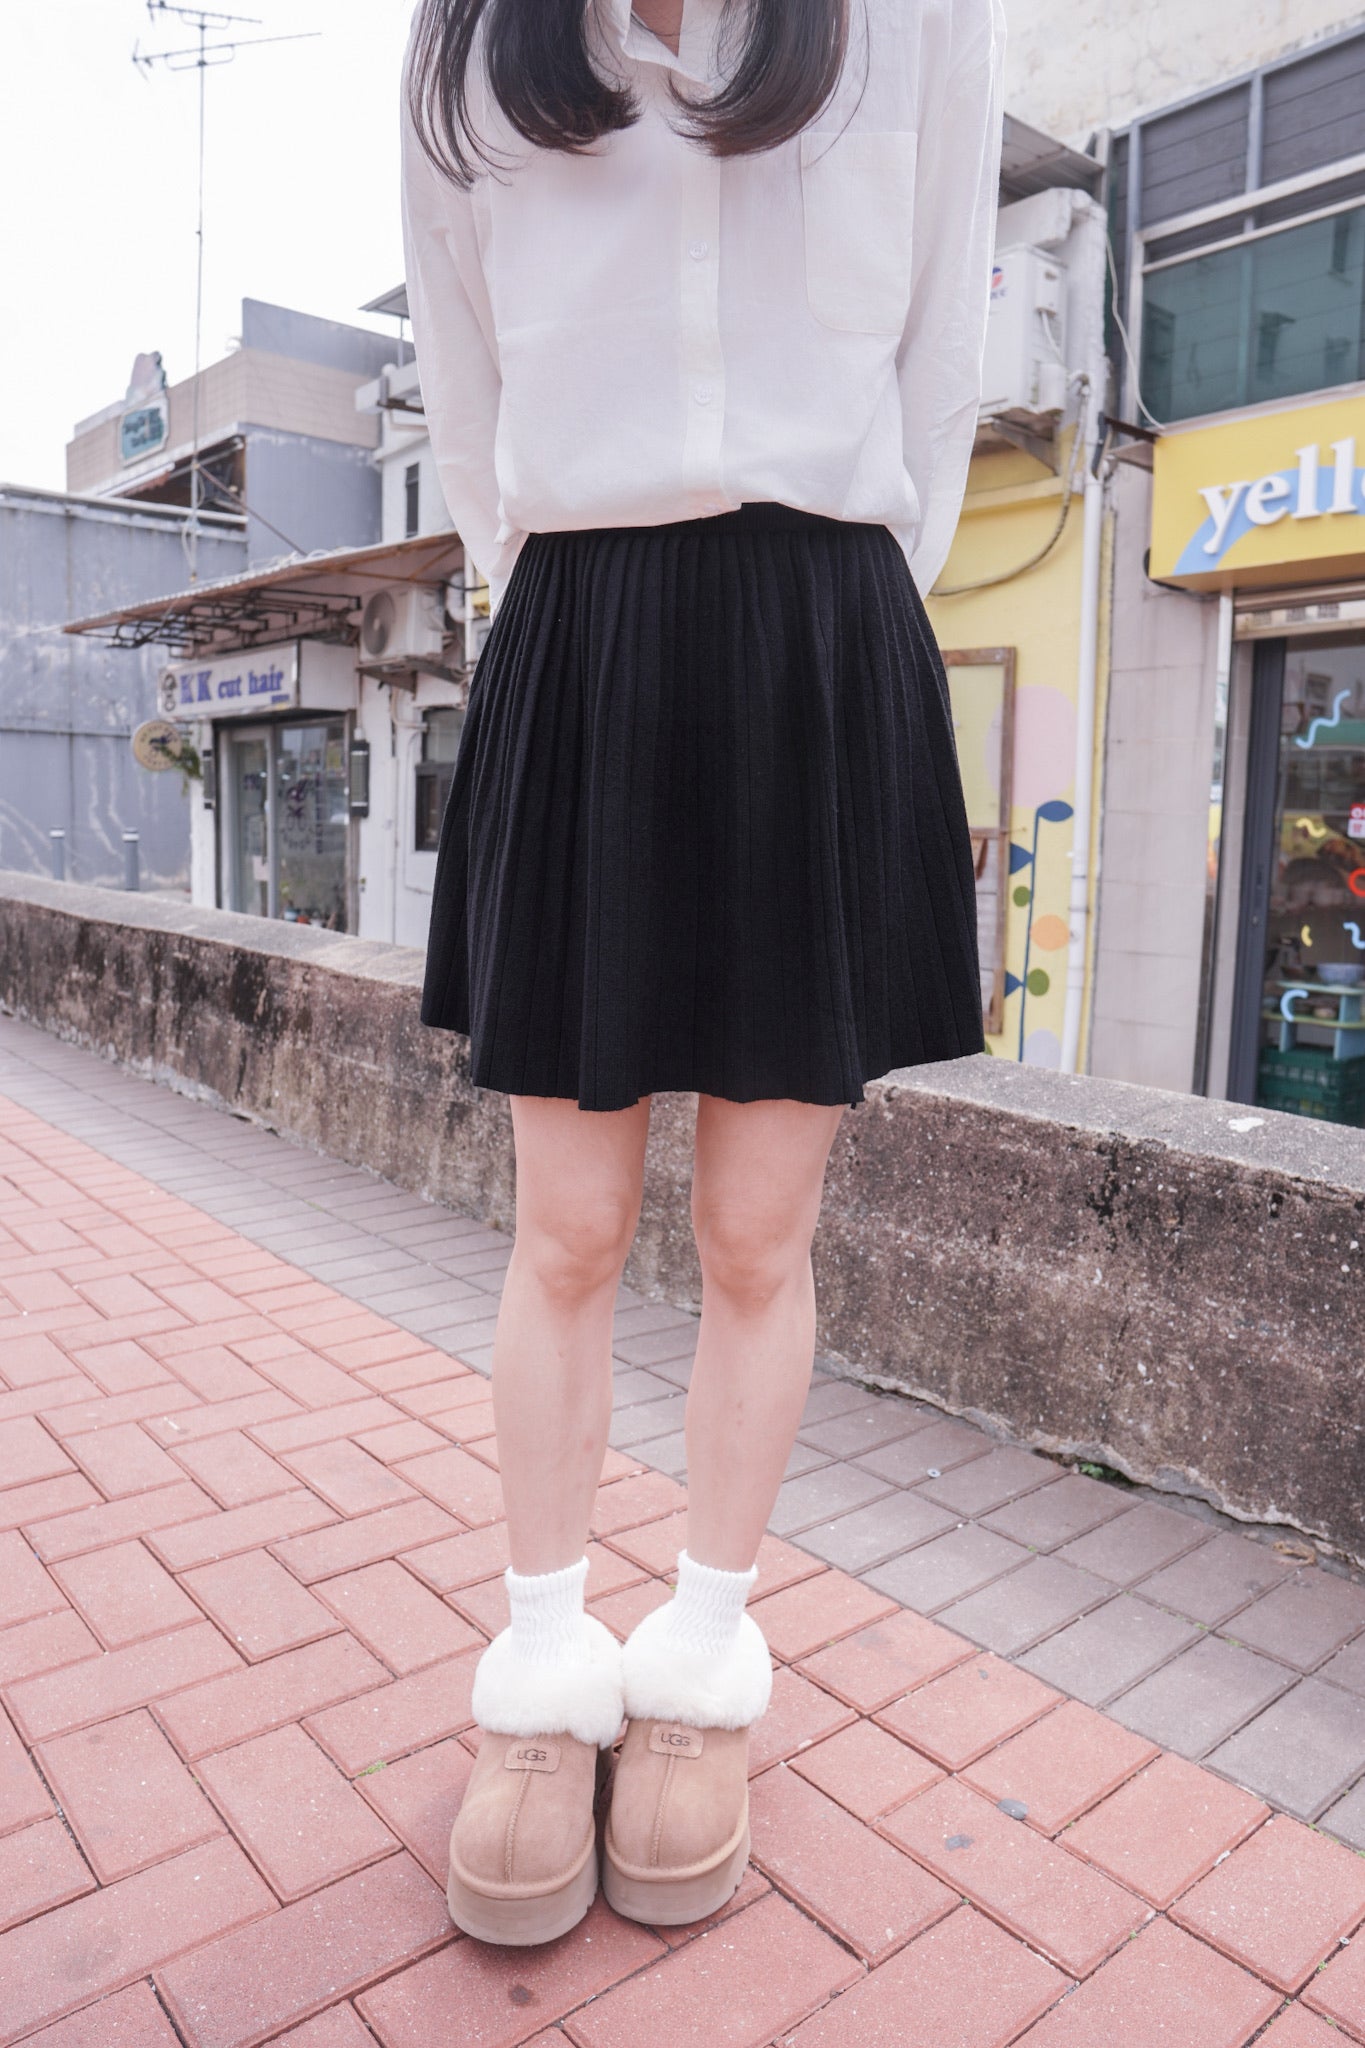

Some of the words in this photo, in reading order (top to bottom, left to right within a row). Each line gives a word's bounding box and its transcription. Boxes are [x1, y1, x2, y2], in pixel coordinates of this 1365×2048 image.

[1197, 437, 1365, 554] yell
[218, 676, 242, 699] cut
[248, 664, 284, 695] hair
[660, 1732, 691, 1747] UGG
[517, 1748, 548, 1762] UGG
